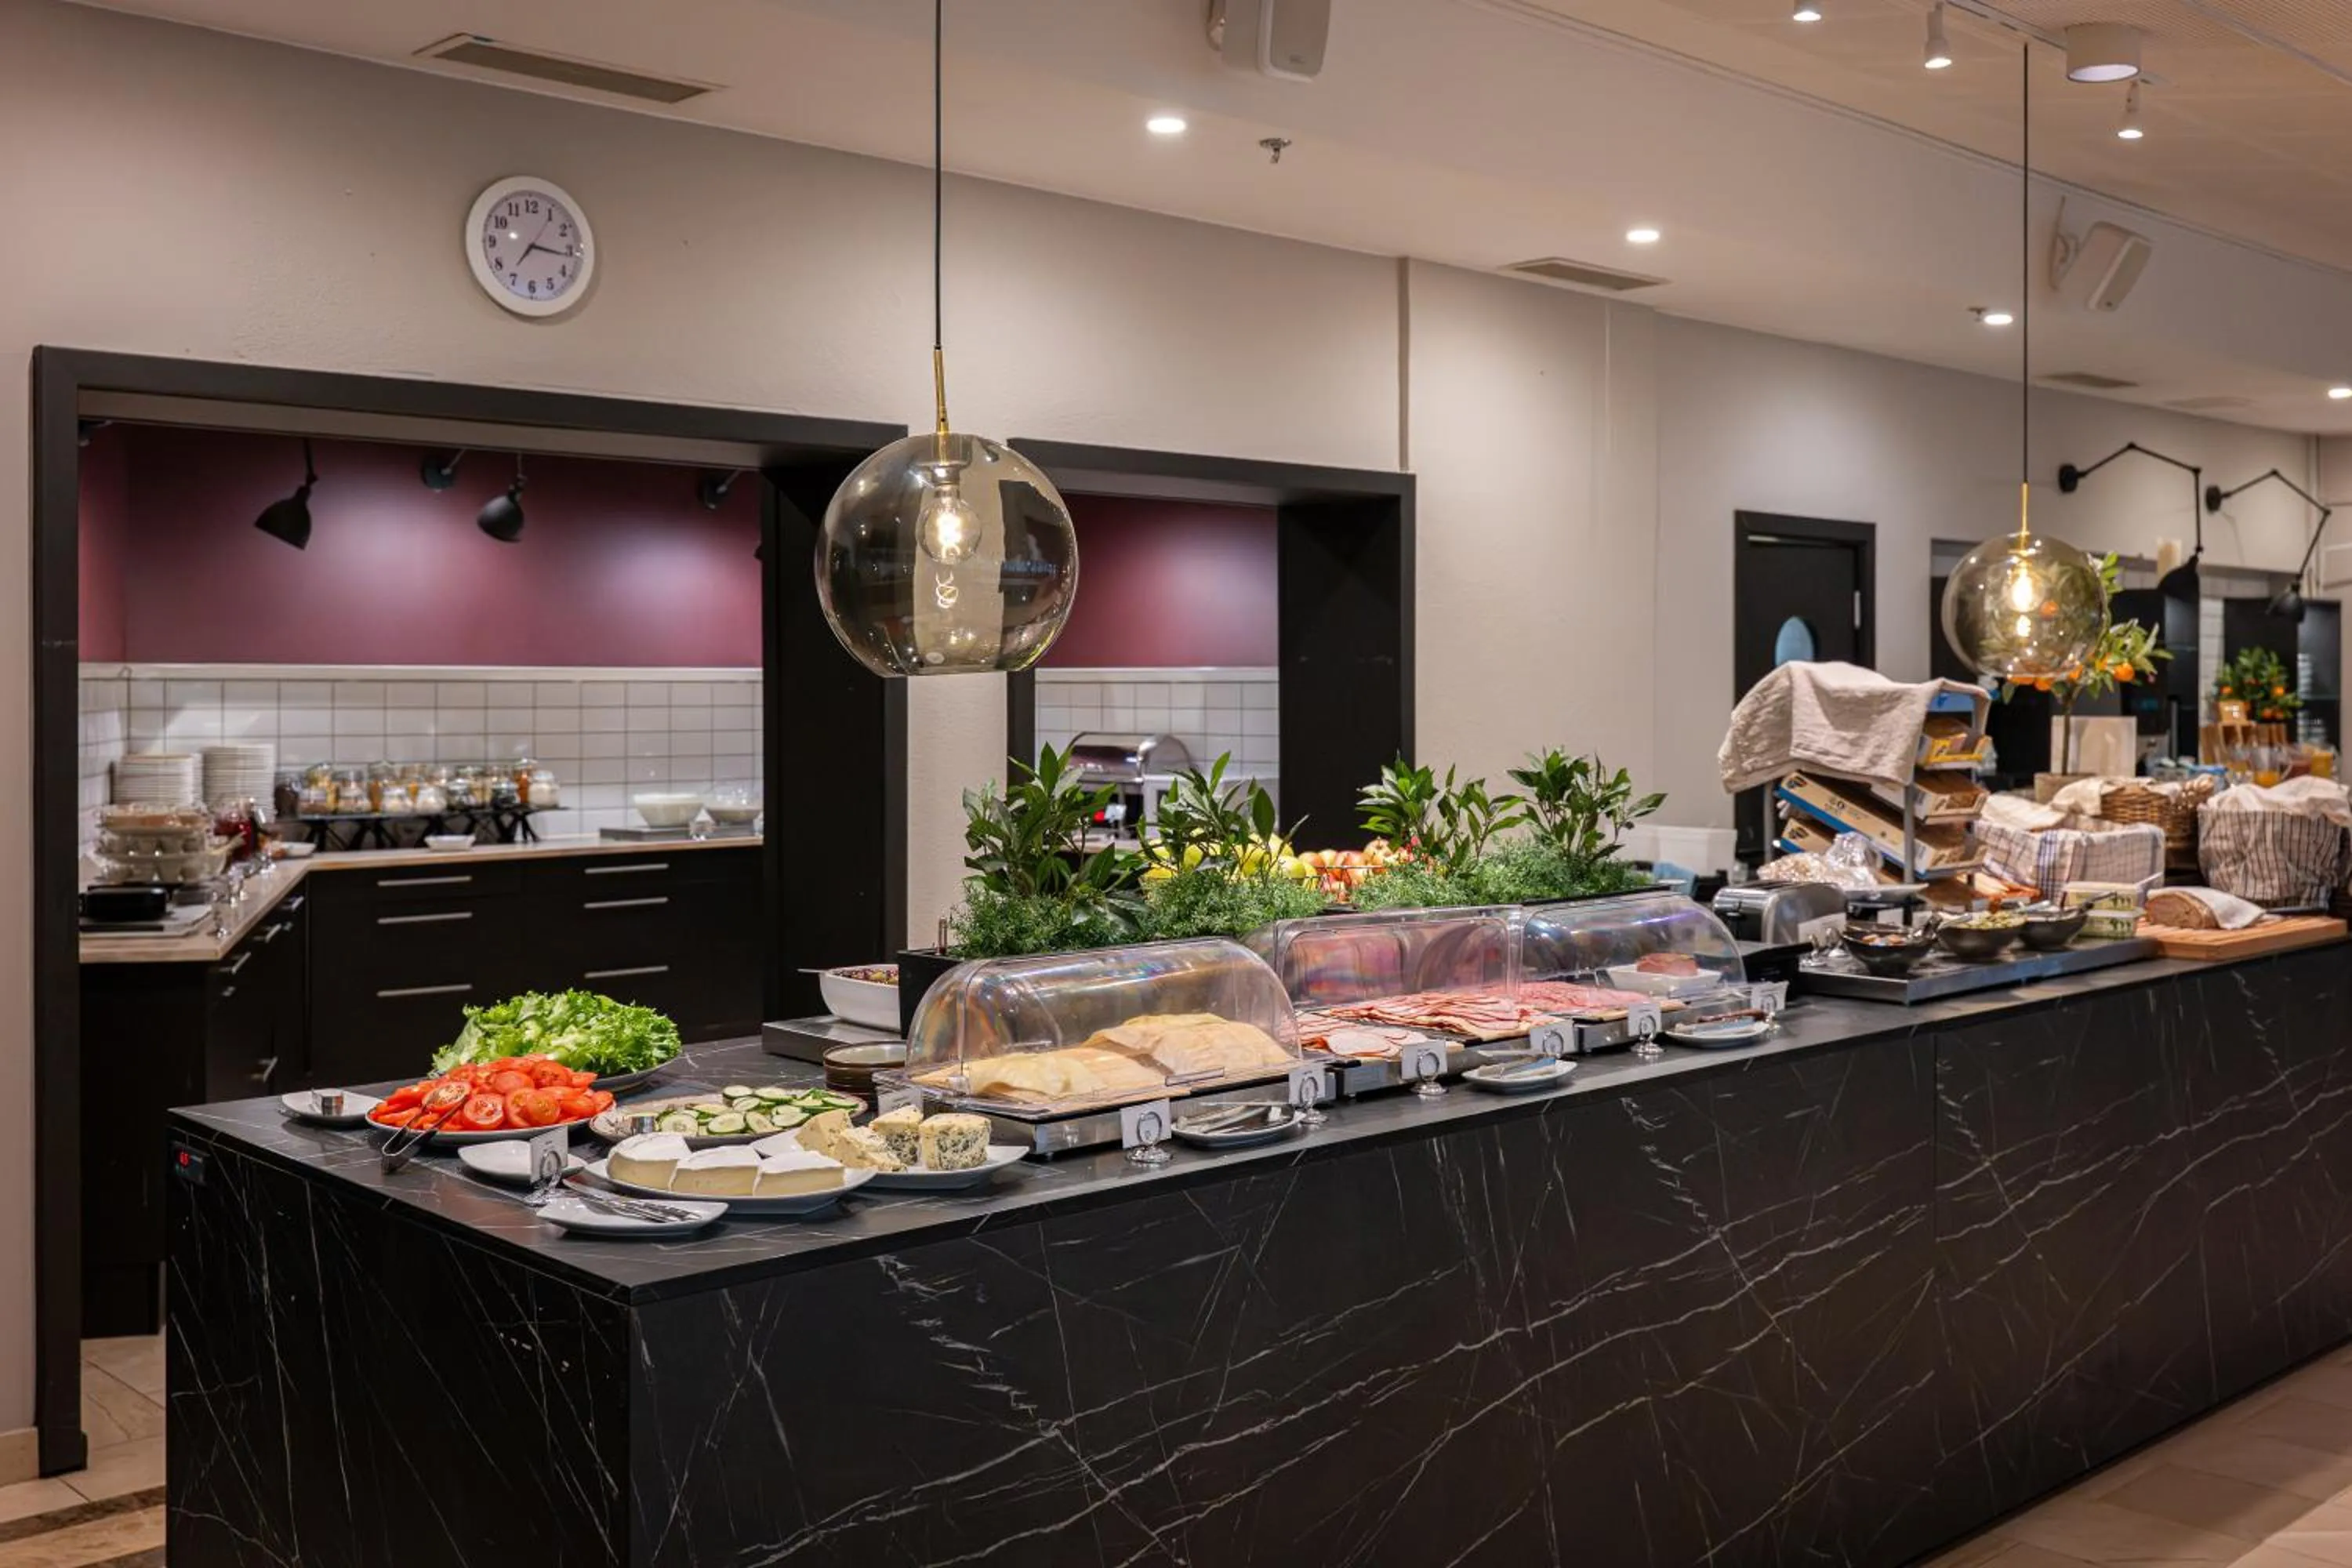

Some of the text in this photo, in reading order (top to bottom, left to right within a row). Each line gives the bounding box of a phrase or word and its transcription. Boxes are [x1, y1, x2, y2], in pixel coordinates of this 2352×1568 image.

[508, 203, 519, 217] 11
[524, 200, 539, 214] 12
[547, 209, 553, 222] 1
[495, 216, 507, 229] 10
[559, 224, 568, 237] 2
[488, 236, 496, 248] 9
[566, 245, 573, 257] 3
[494, 258, 503, 270] 8
[559, 265, 566, 277] 4
[510, 273, 518, 286] 7
[546, 278, 554, 290] 5
[528, 281, 536, 293] 6
